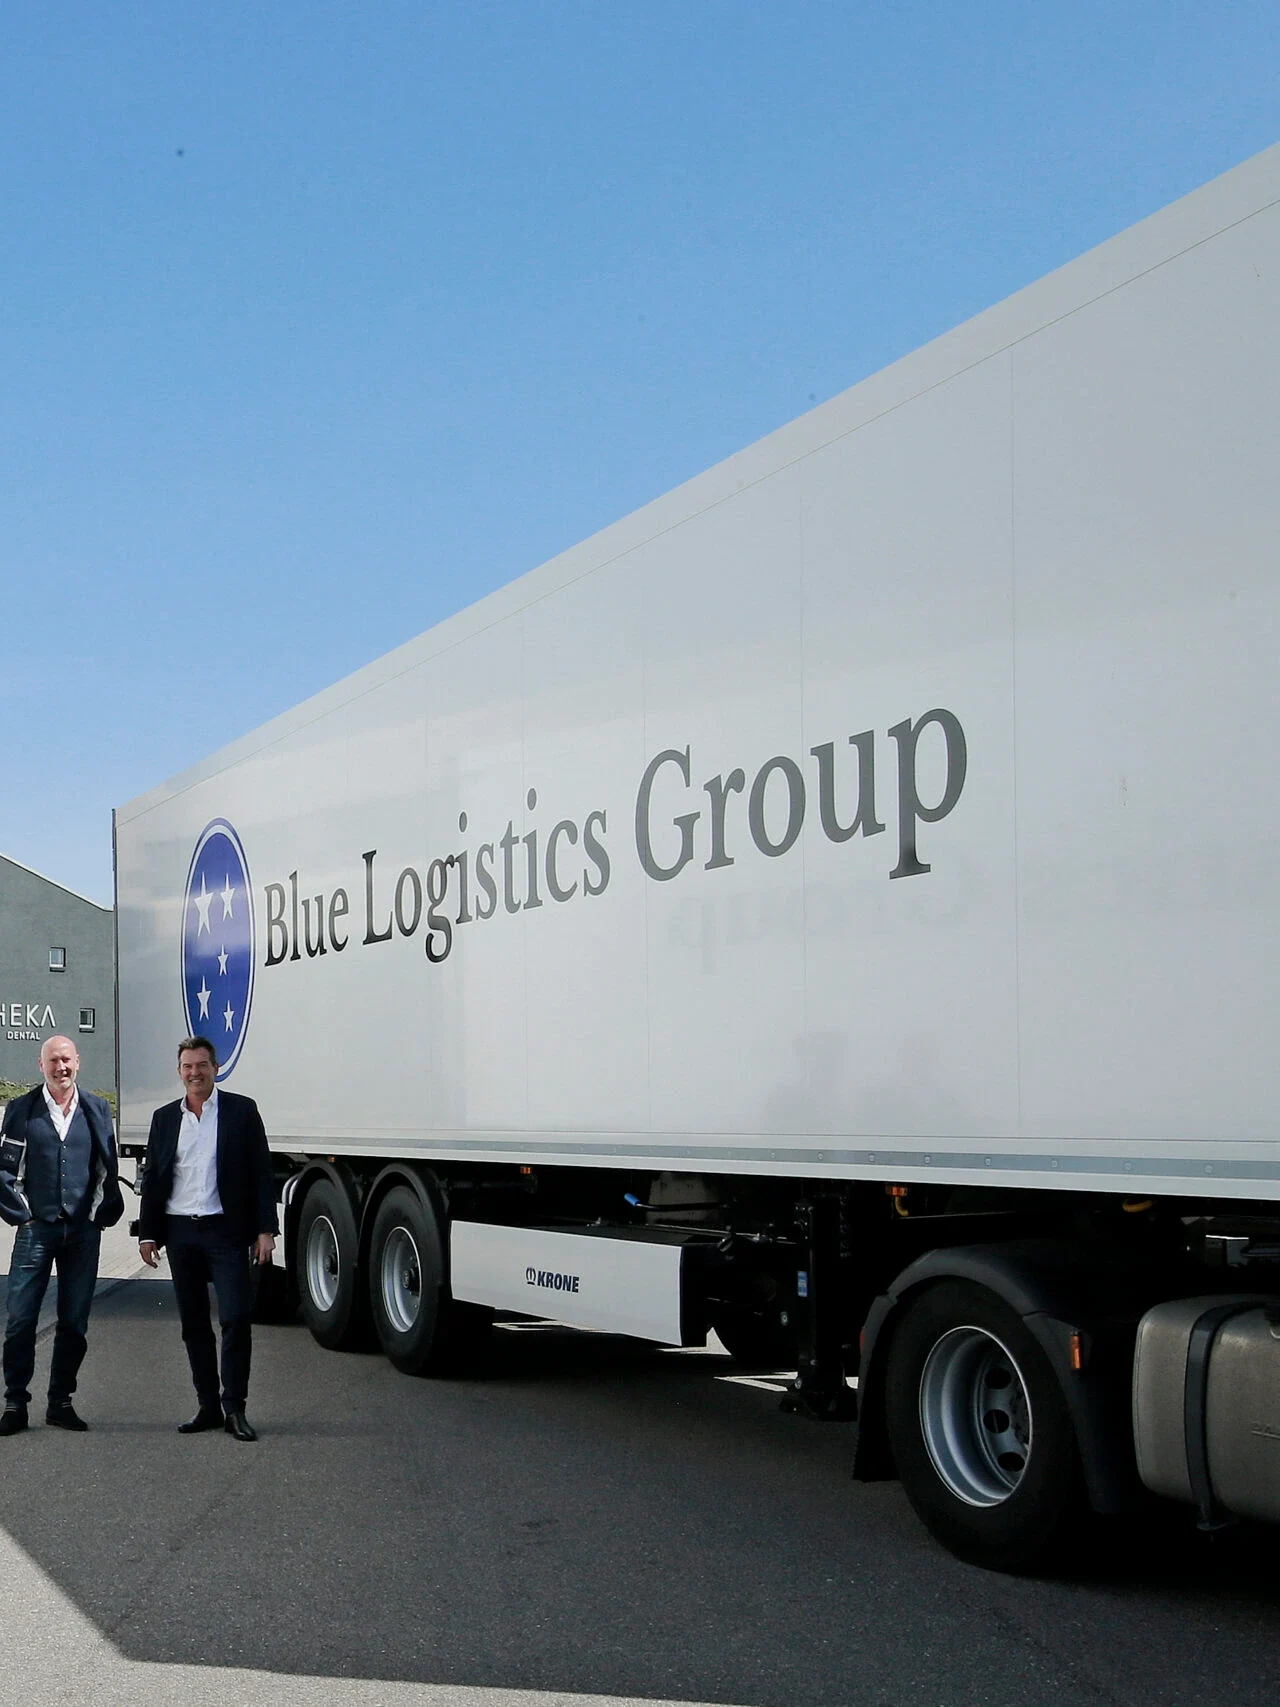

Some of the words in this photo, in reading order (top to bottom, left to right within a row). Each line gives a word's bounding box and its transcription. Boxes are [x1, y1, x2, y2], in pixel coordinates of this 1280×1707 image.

[264, 870, 349, 967] Blue
[362, 787, 611, 964] Logistics
[635, 708, 968, 881] Group
[6, 1030, 41, 1041] DENTAL
[536, 1270, 580, 1293] KRONE
